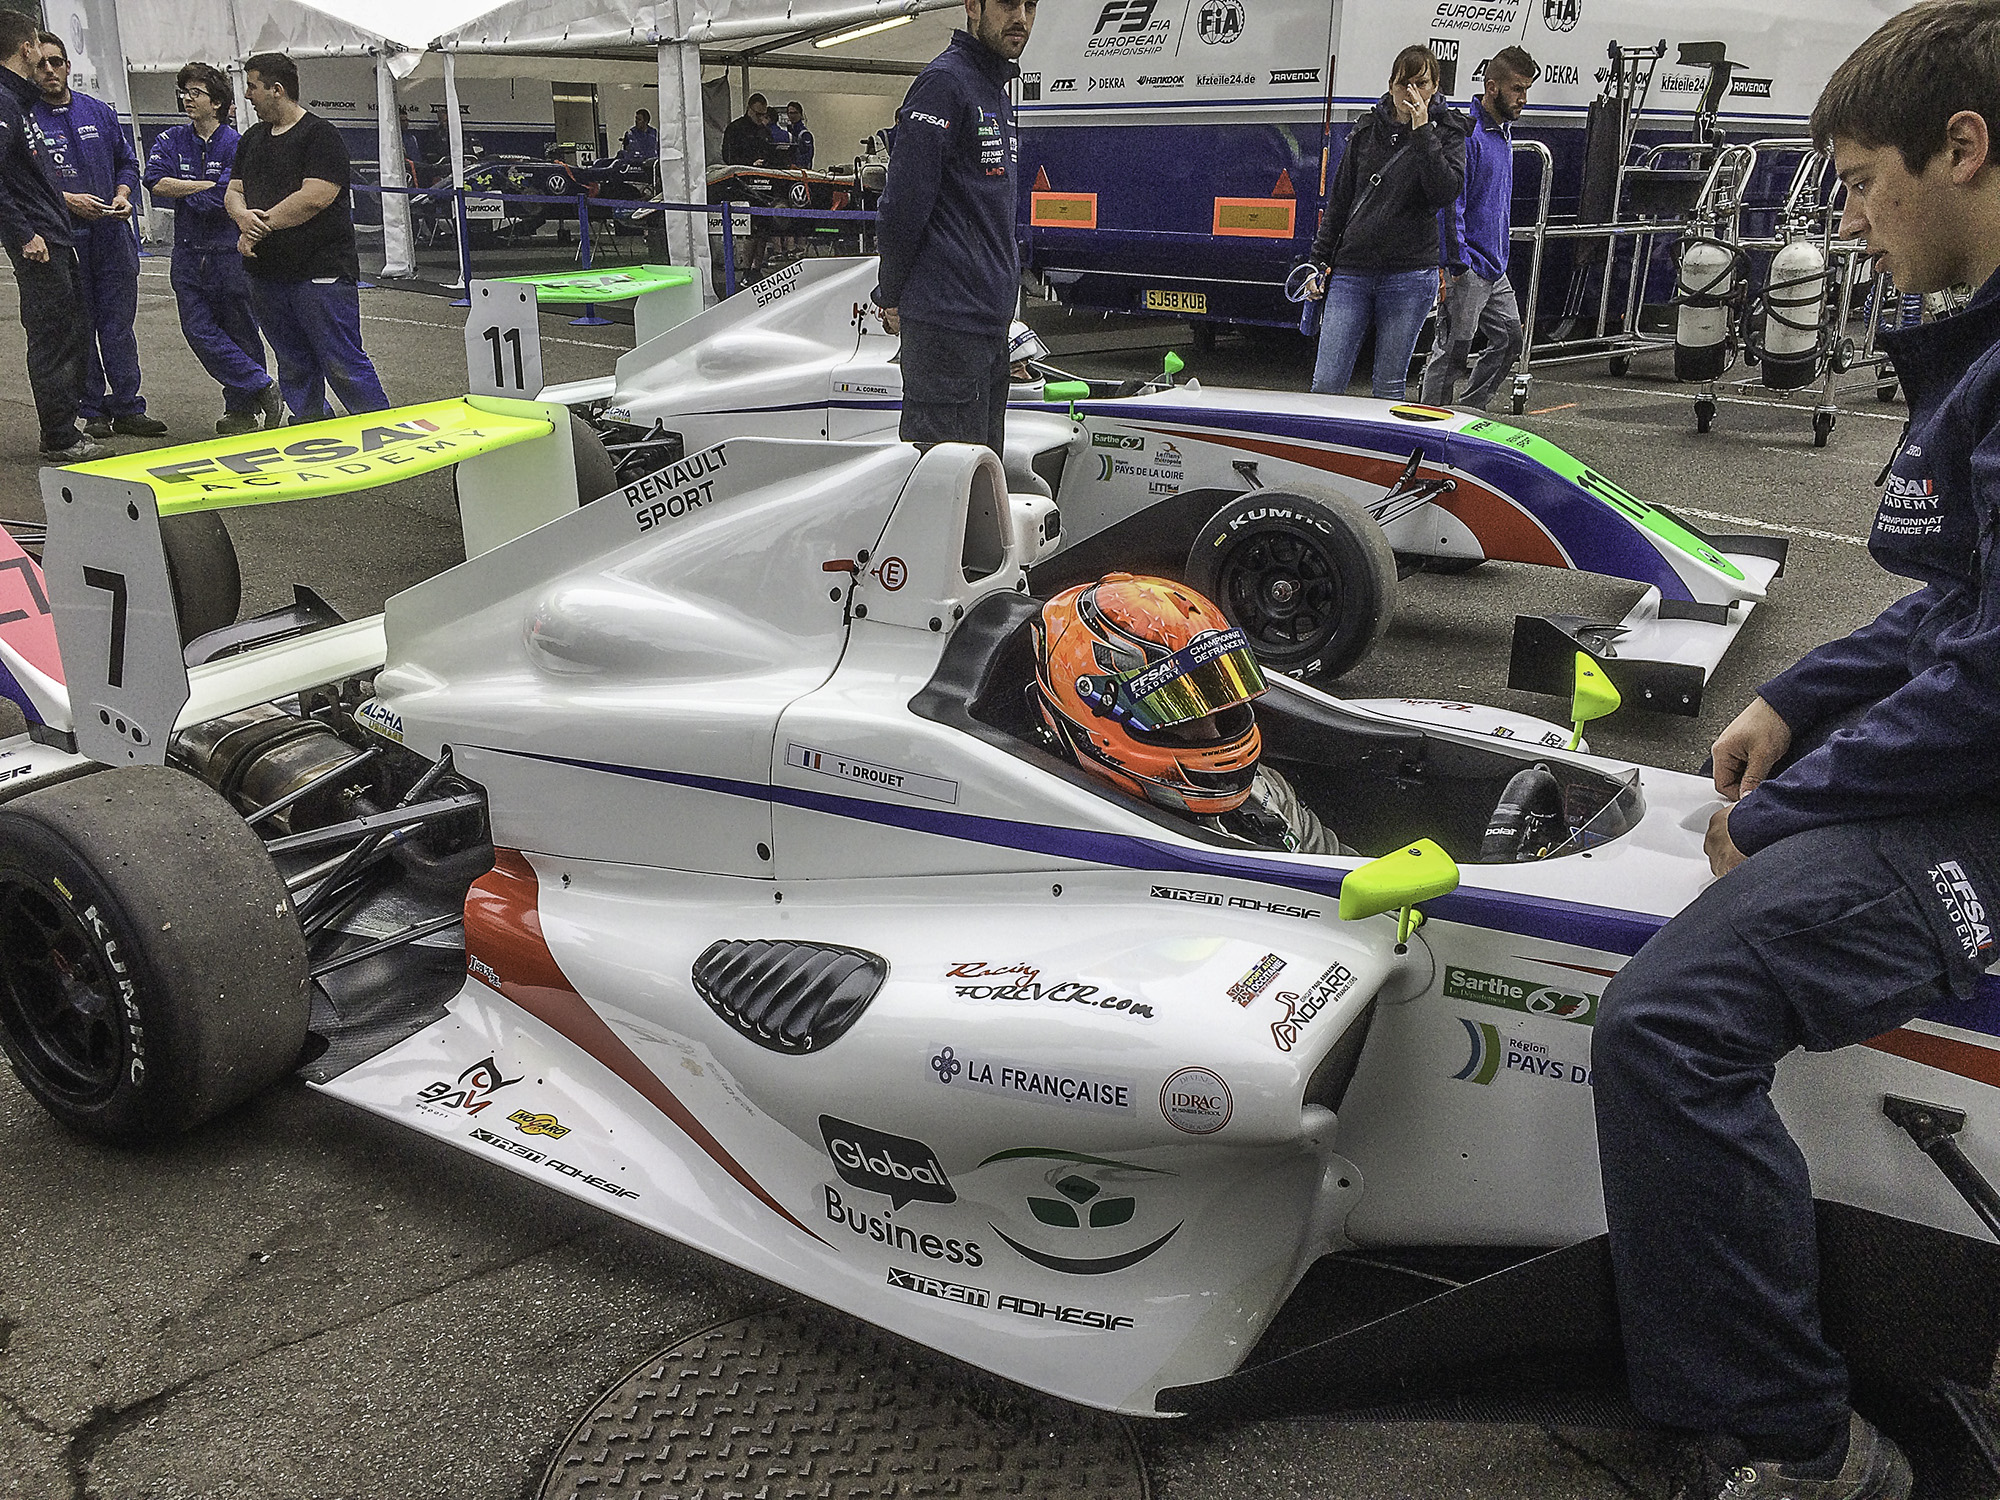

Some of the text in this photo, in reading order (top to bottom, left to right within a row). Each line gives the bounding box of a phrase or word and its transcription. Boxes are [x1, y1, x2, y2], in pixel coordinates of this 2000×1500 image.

[1092, 0, 1171, 35] F3 FIA
[1431, 18, 1511, 34] CHAMPIONSHIP
[1436, 3, 1517, 23] EUROPEAN
[1083, 46, 1163, 58] CHAMPIONSHIP
[1088, 34, 1168, 48] EUROPEAN
[1429, 40, 1458, 61] ADAC
[1023, 73, 1041, 84] ADAC
[1051, 78, 1077, 89] ATS
[1099, 77, 1125, 89] DEKRA
[1196, 74, 1256, 86] kfzteile24.de
[1274, 72, 1316, 82] RAVENOL
[1544, 64, 1579, 85] DEKRA
[1733, 81, 1769, 93] RAVENOL
[909, 111, 948, 129] FFSA
[751, 262, 805, 296] RENAULT
[757, 279, 798, 308] SPORT
[1149, 291, 1205, 310] SJ58 KUB
[483, 327, 525, 390] 11
[146, 424, 430, 485] FFSA
[201, 429, 486, 492] ACADEMY
[623, 444, 729, 508] RENAULT
[1114, 465, 1184, 480] PAYS DE LA LOIRE
[635, 480, 715, 533] SPORT
[1883, 523, 1923, 535] FRANCE
[1924, 525, 1942, 535] F4
[887, 562, 900, 585] E
[83, 565, 128, 688] 7
[1194, 653, 1209, 665] DE
[1129, 661, 1172, 693] FFSA
[1134, 668, 1181, 699] ACADEMY
[360, 702, 404, 733] ALPHA
[838, 762, 905, 787] T. DROUET
[1485, 827, 1518, 838] polar
[1151, 885, 1322, 919] XTREM ADHESIF
[1927, 870, 1977, 960] ACADEMY
[1939, 861, 1990, 947] FFSA
[945, 962, 1041, 988] Racing
[1450, 970, 1524, 999] Sarthe
[84, 904, 145, 1086] KUMHO
[954, 981, 1155, 1019] FOREVER.com
[1289, 965, 1352, 1031] NOGARO
[1509, 1038, 1547, 1055] Région
[1506, 1051, 1592, 1085] PAYS D
[968, 1060, 1129, 1108] LA FRANÇAISE
[1171, 1092, 1222, 1111] IDRAC
[469, 1128, 641, 1200] XTREM ADHESIF
[830, 1138, 946, 1186] Global
[823, 1184, 985, 1268] Business
[887, 1267, 1135, 1332] XTREM ADHESIF
